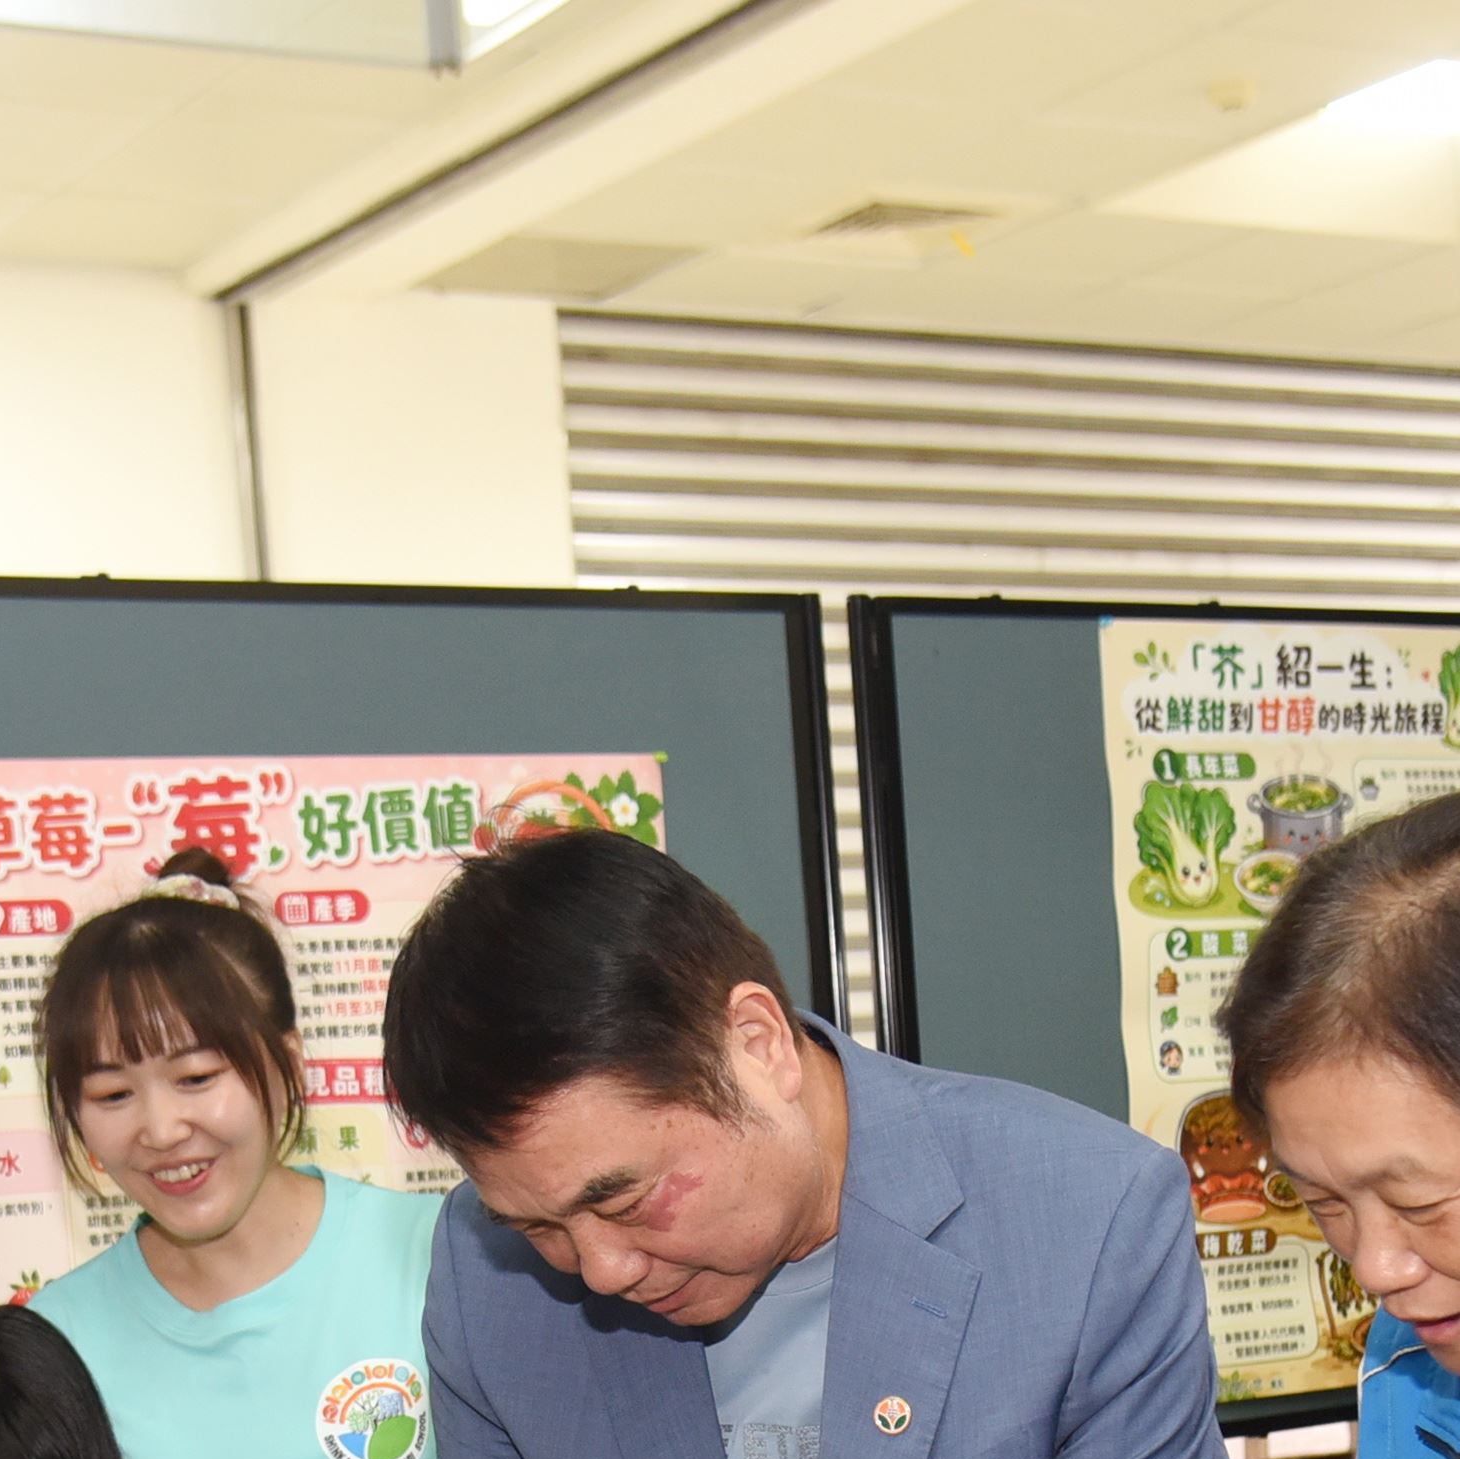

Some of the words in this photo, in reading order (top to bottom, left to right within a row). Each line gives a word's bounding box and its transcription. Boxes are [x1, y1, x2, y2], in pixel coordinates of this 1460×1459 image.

[1134, 694, 1445, 737] 從鮮甜到甘醇的時光旅程
[1160, 751, 1176, 780] 1
[7, 903, 60, 934] 產地
[311, 897, 358, 923] 產季
[1171, 930, 1189, 959] 2
[415, 1411, 426, 1451] SCHOOL
